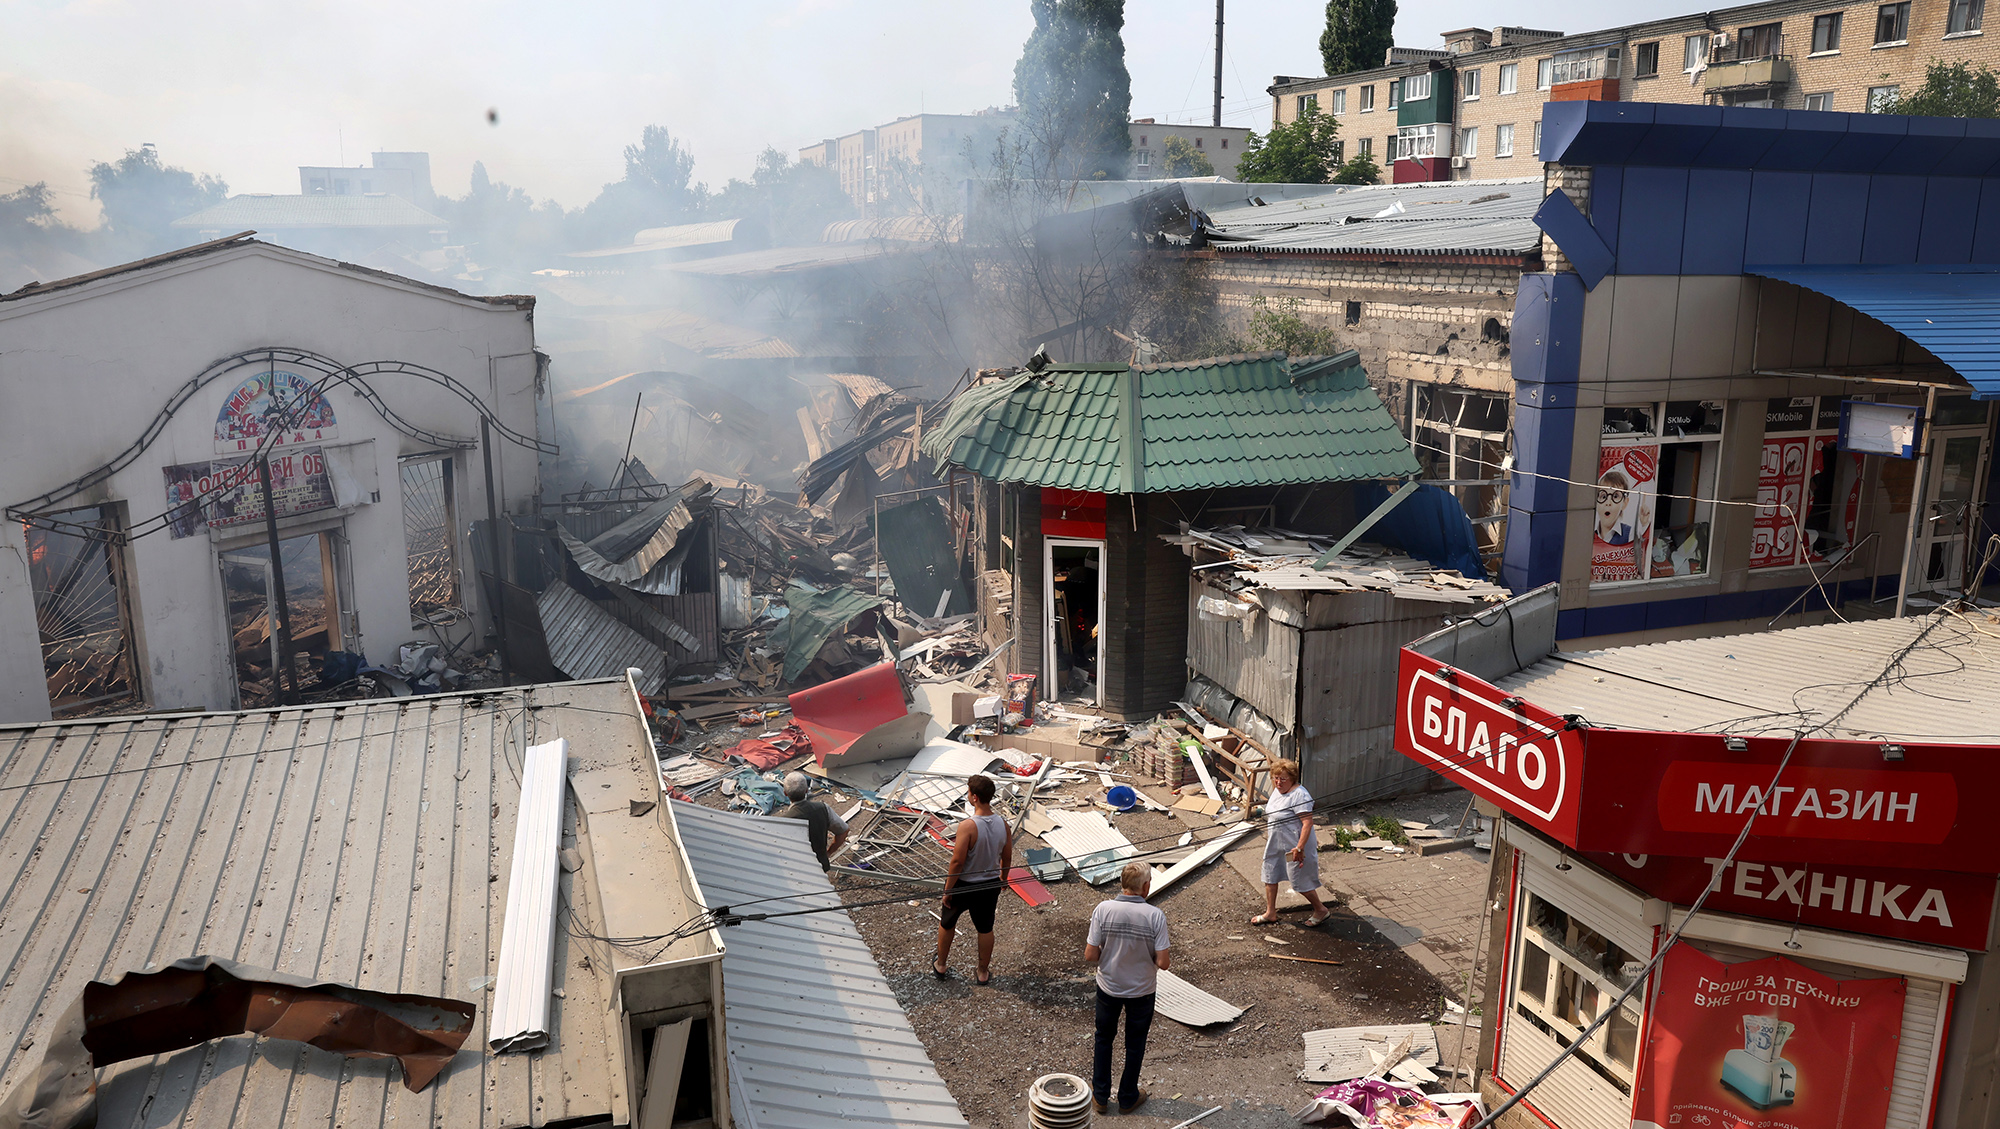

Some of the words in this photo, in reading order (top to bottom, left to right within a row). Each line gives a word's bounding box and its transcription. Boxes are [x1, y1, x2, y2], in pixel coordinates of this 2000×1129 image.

[1766, 412, 1804, 422] SKMobile
[237, 429, 322, 450] ПРЯЖА
[281, 456, 294, 478] И
[253, 485, 311, 500] АСРТИМЕНТЕ
[252, 498, 290, 511] ВЗРЛЫХ
[1593, 565, 1605, 576] ПО
[1423, 695, 1547, 790] БЛАГО
[1694, 782, 1918, 823] МАГАЗИН
[1704, 857, 1953, 928] ТЕХНІКА
[1694, 992, 1732, 1008] ВЖЕ
[1736, 990, 1798, 1009] ГОТОВІ
[1698, 976, 1749, 993] ГРОШІ
[1754, 975, 1777, 989] ЗА
[1784, 977, 1861, 1007] ТЕХНІКУ
[1760, 1025, 1774, 1034] 200
[1673, 1102, 1720, 1114] приймаємо
[1722, 1109, 1755, 1127] більше
[1758, 1120, 1772, 1128] 200
